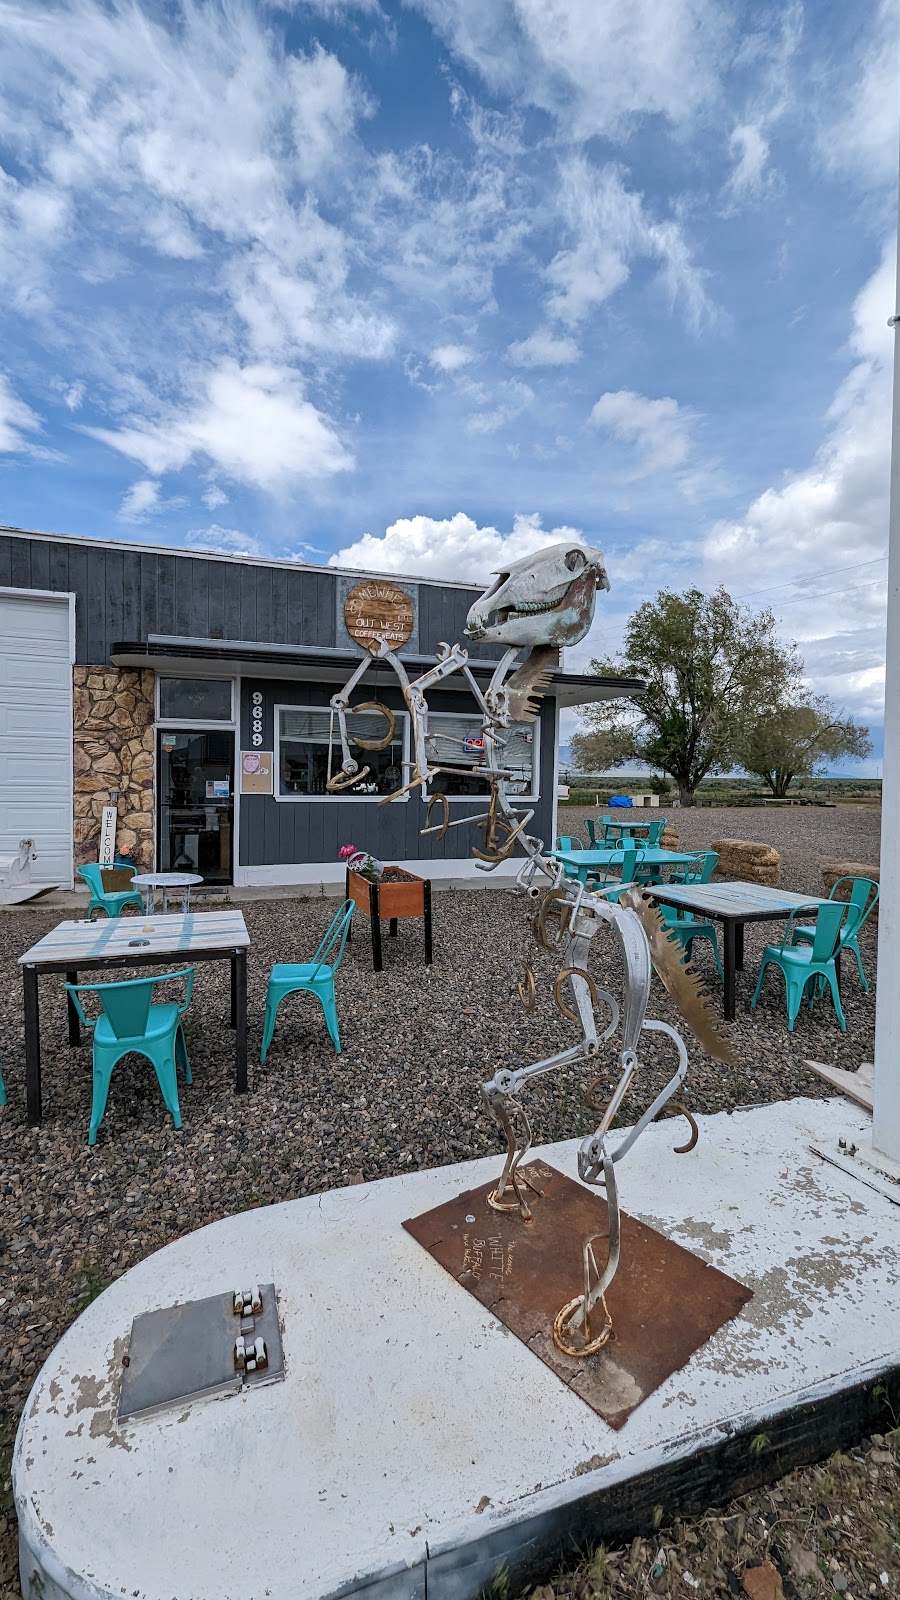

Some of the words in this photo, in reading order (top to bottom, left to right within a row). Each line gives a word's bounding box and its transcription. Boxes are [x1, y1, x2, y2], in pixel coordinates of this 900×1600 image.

[355, 618, 375, 628] OUT
[380, 620, 405, 631] WEST
[354, 629, 382, 638] COFFEE
[385, 632, 403, 641] EATS
[252, 691, 263, 746] 9689
